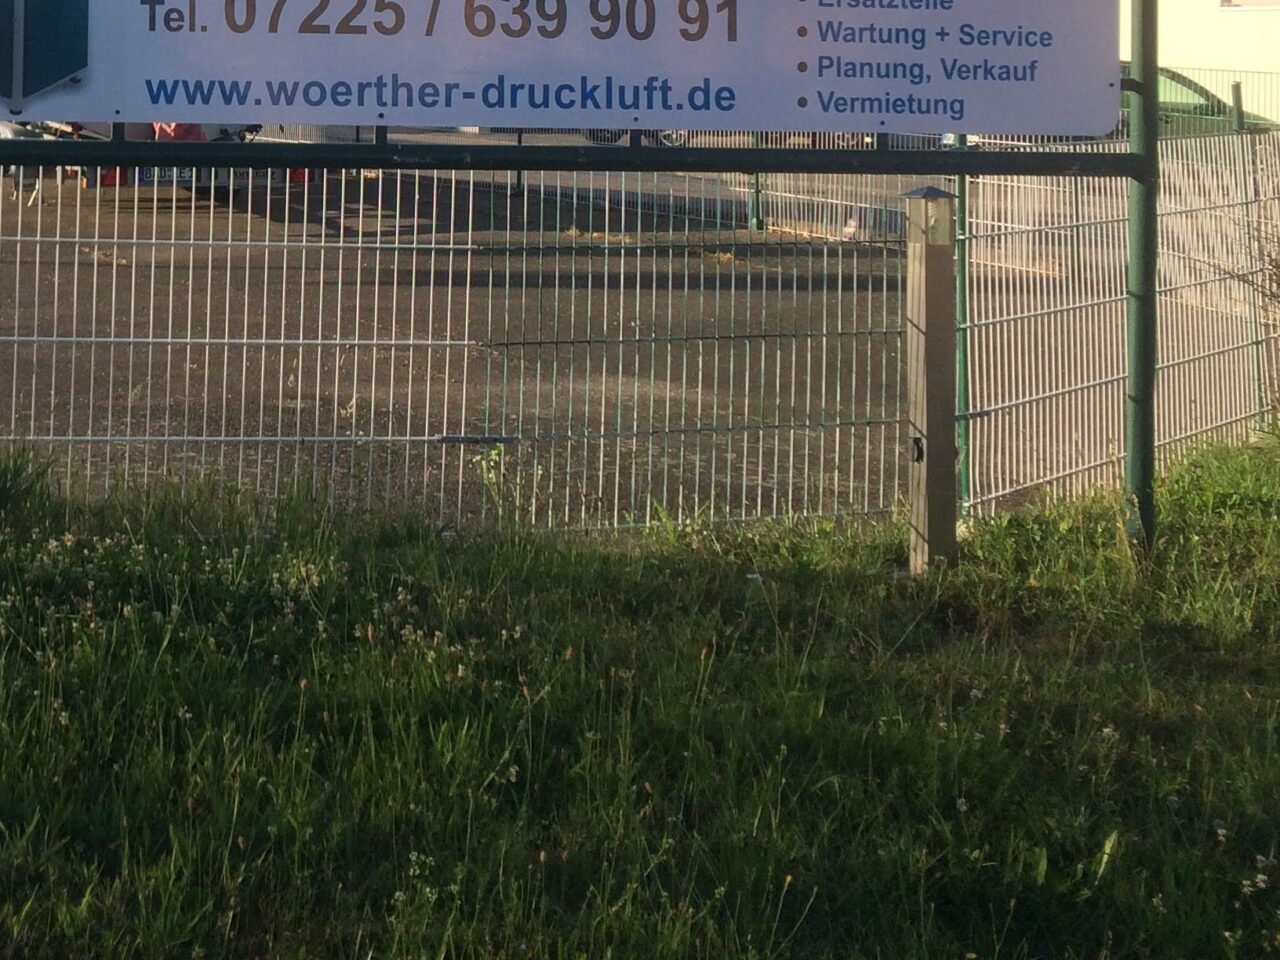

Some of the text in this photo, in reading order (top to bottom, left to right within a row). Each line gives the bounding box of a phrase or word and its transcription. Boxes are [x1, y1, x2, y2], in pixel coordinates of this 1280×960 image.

[140, 0, 208, 33] Tel.
[817, 20, 1053, 50] Wartung + Service
[817, 56, 1038, 84] Planung, Verkauf
[145, 73, 736, 112] www.woerther-druckluft.de
[817, 91, 965, 121] Vermietung
